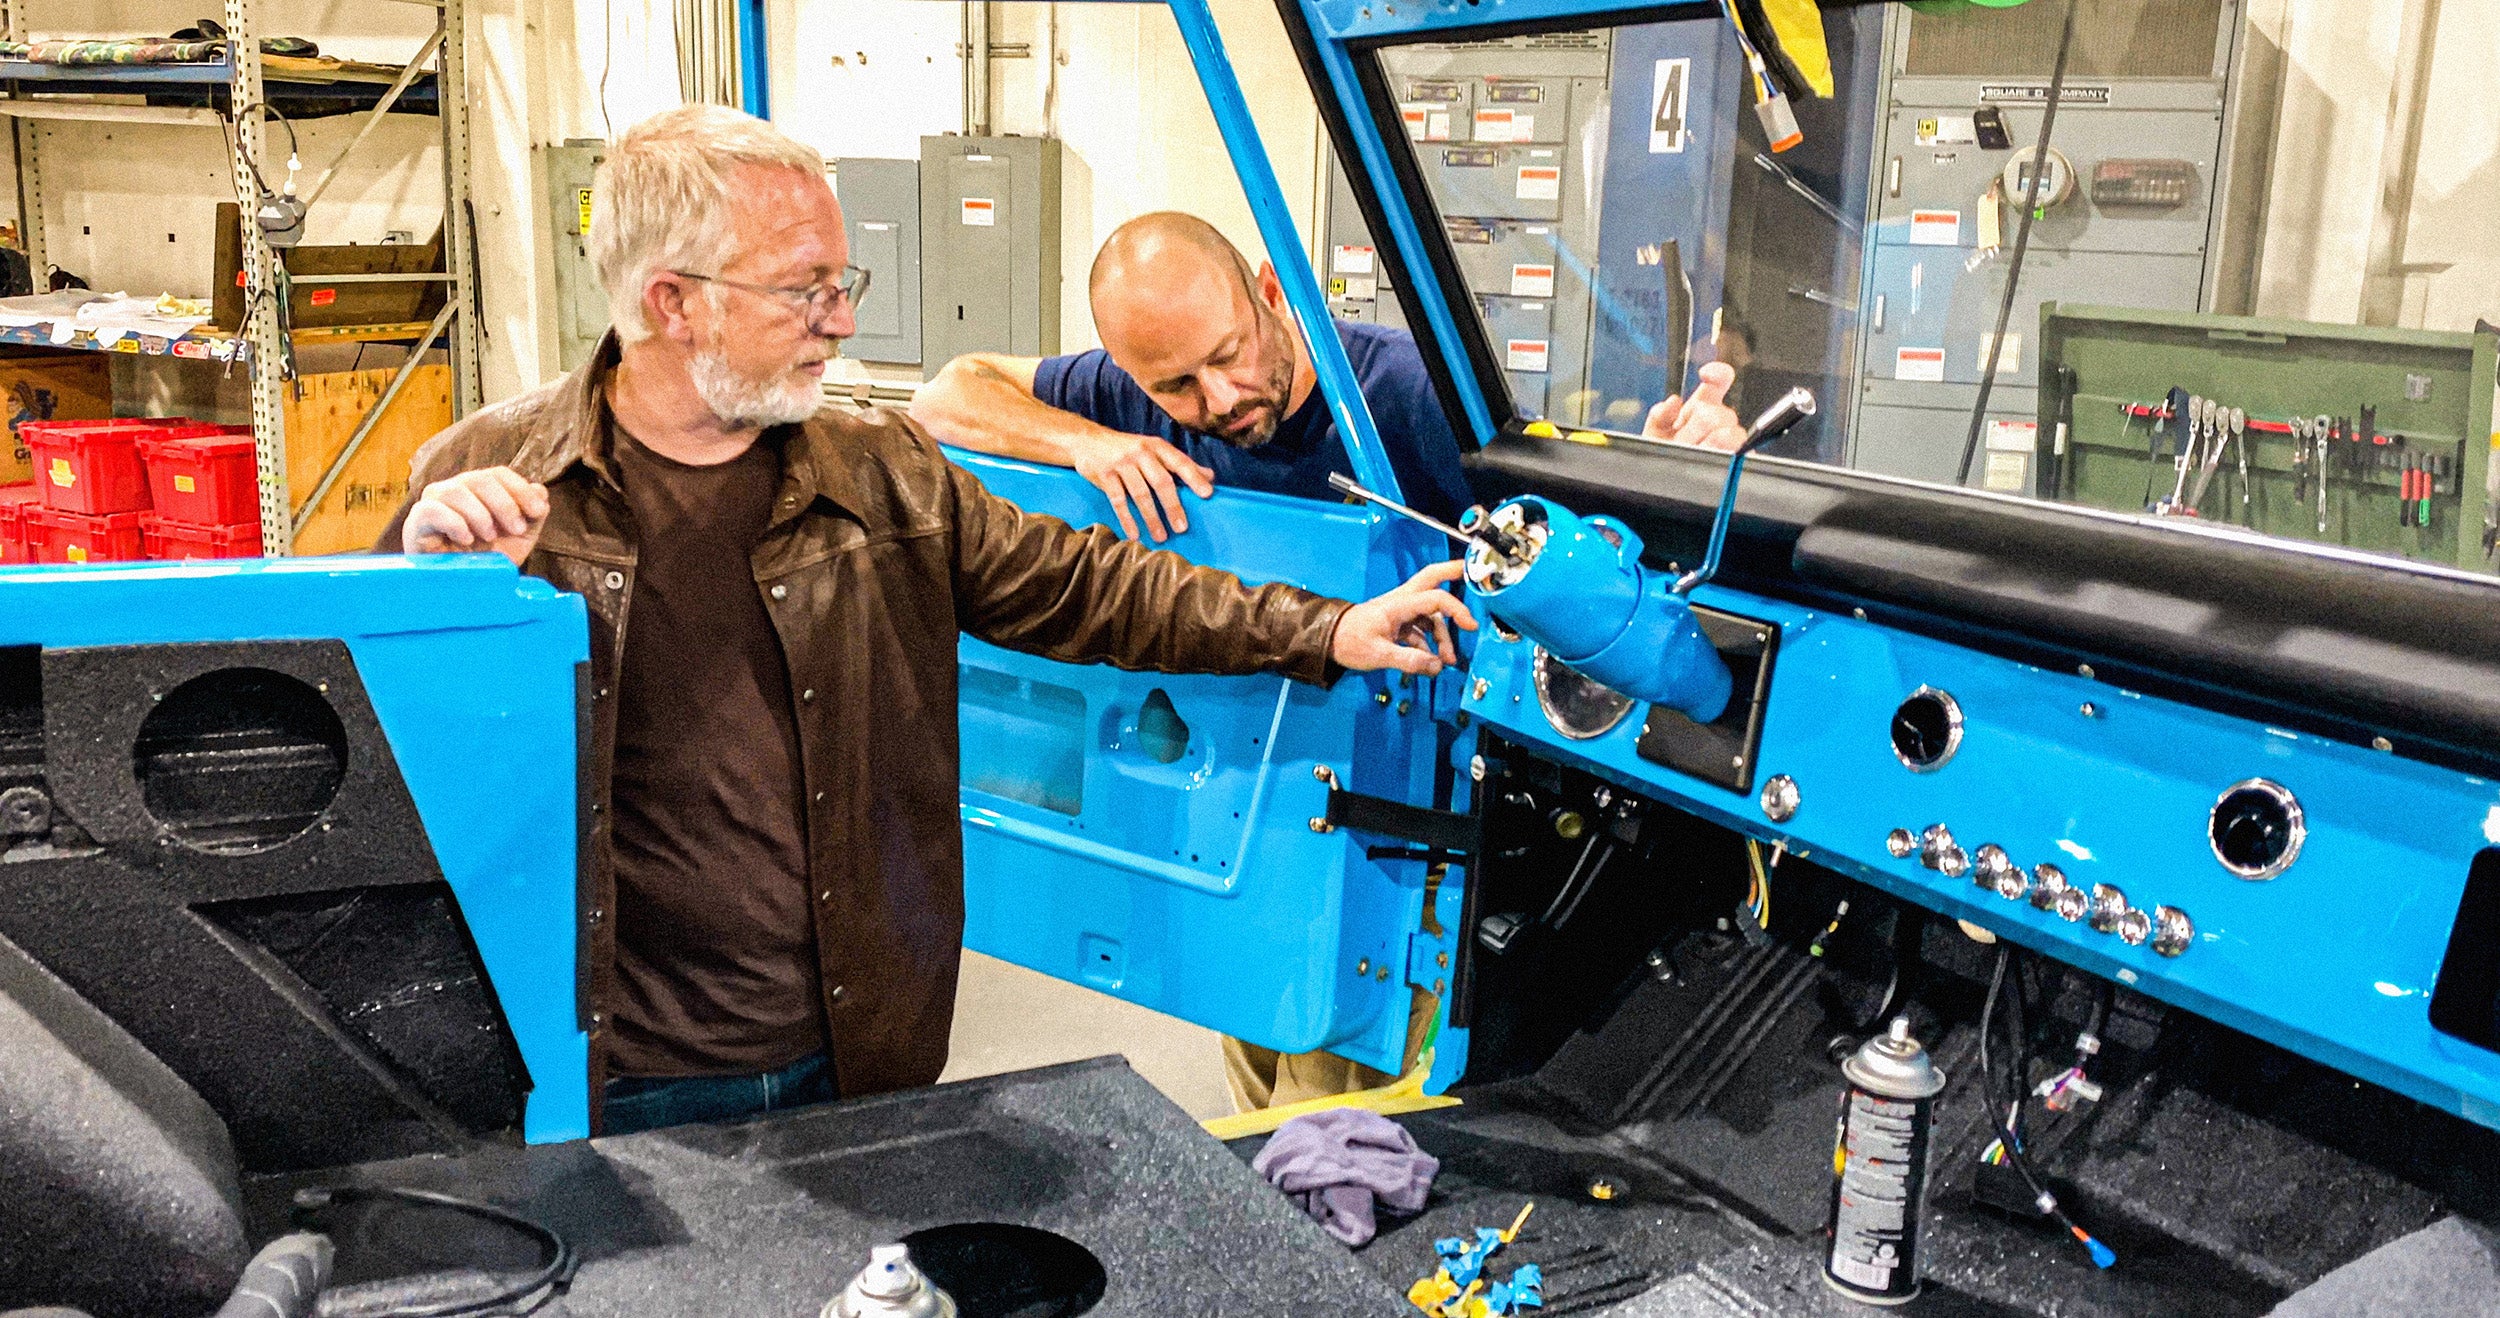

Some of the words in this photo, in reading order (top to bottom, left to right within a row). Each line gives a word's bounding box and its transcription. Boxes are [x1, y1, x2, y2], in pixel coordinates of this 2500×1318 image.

[1655, 64, 1682, 147] 4
[1985, 87, 2028, 98] SQUARE
[2034, 87, 2045, 98] D
[2056, 88, 2105, 98] OMPANY
